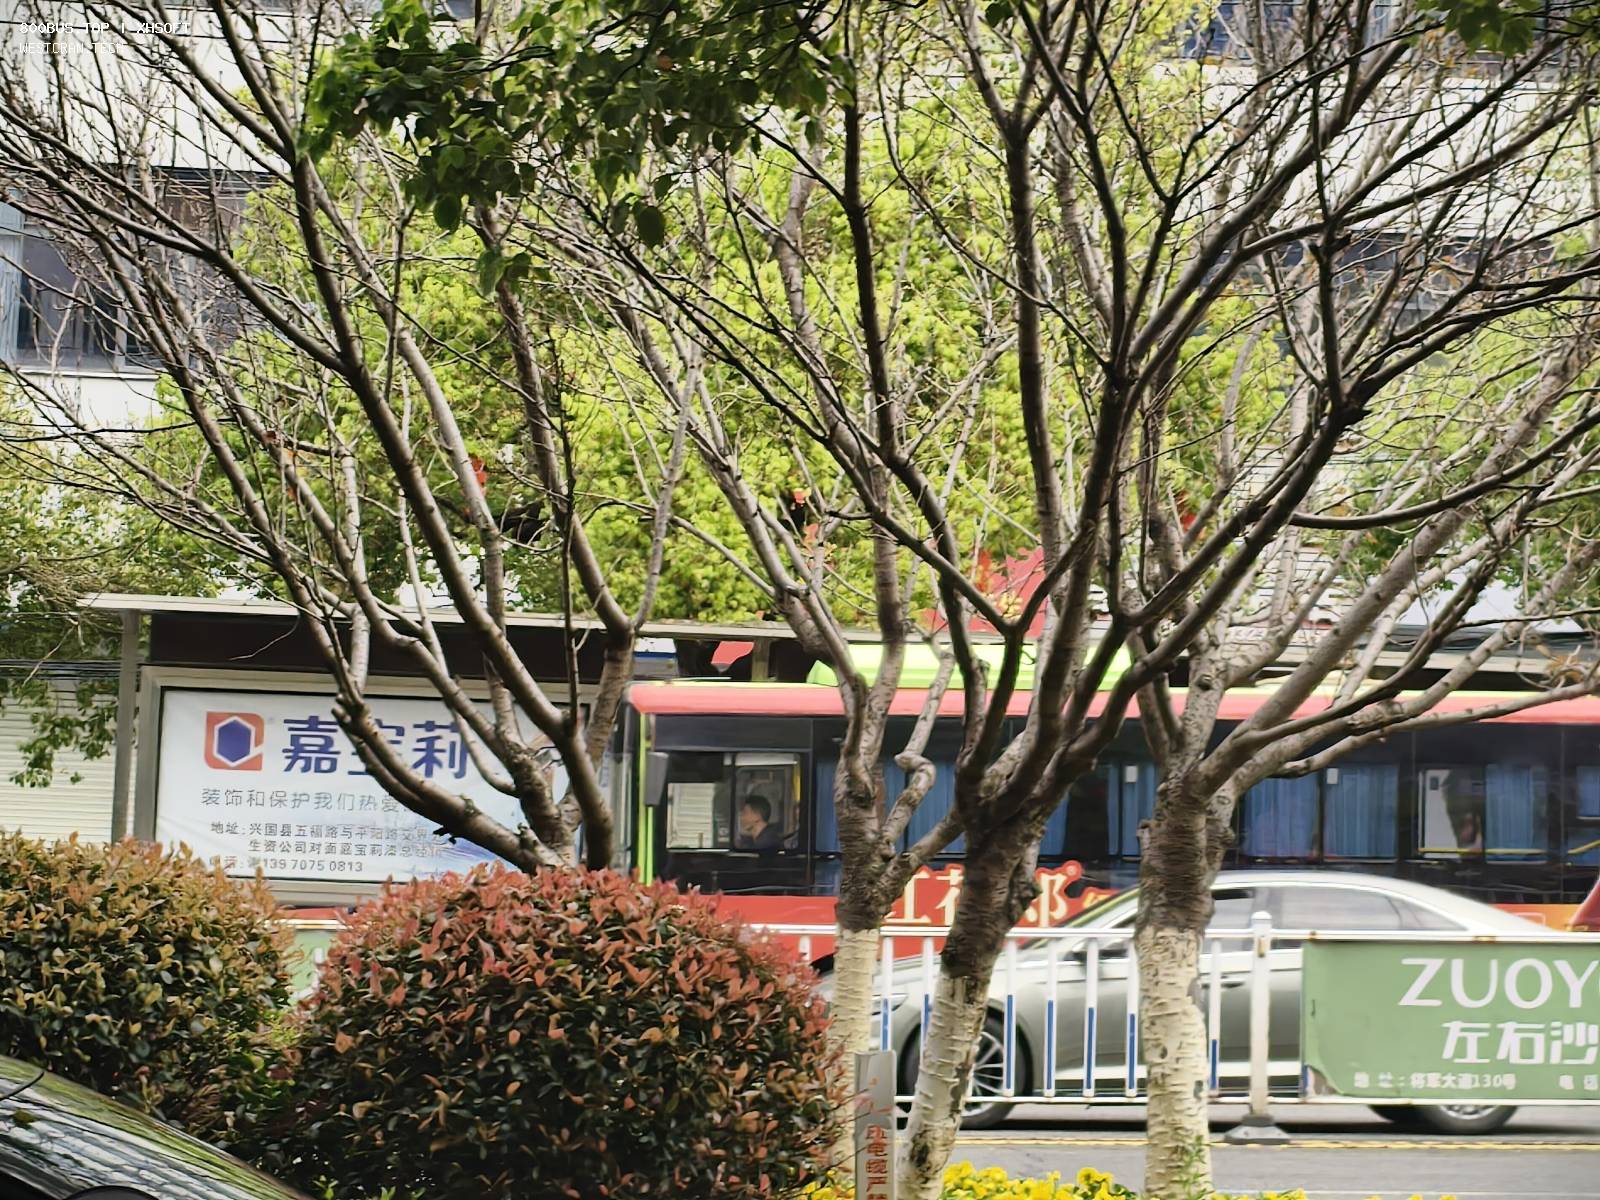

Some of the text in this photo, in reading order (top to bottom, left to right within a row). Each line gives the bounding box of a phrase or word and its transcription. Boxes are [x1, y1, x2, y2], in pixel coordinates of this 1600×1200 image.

[201, 788, 410, 813] 装饰和保护我们热爱
[1397, 957, 1600, 1009] ZUOY
